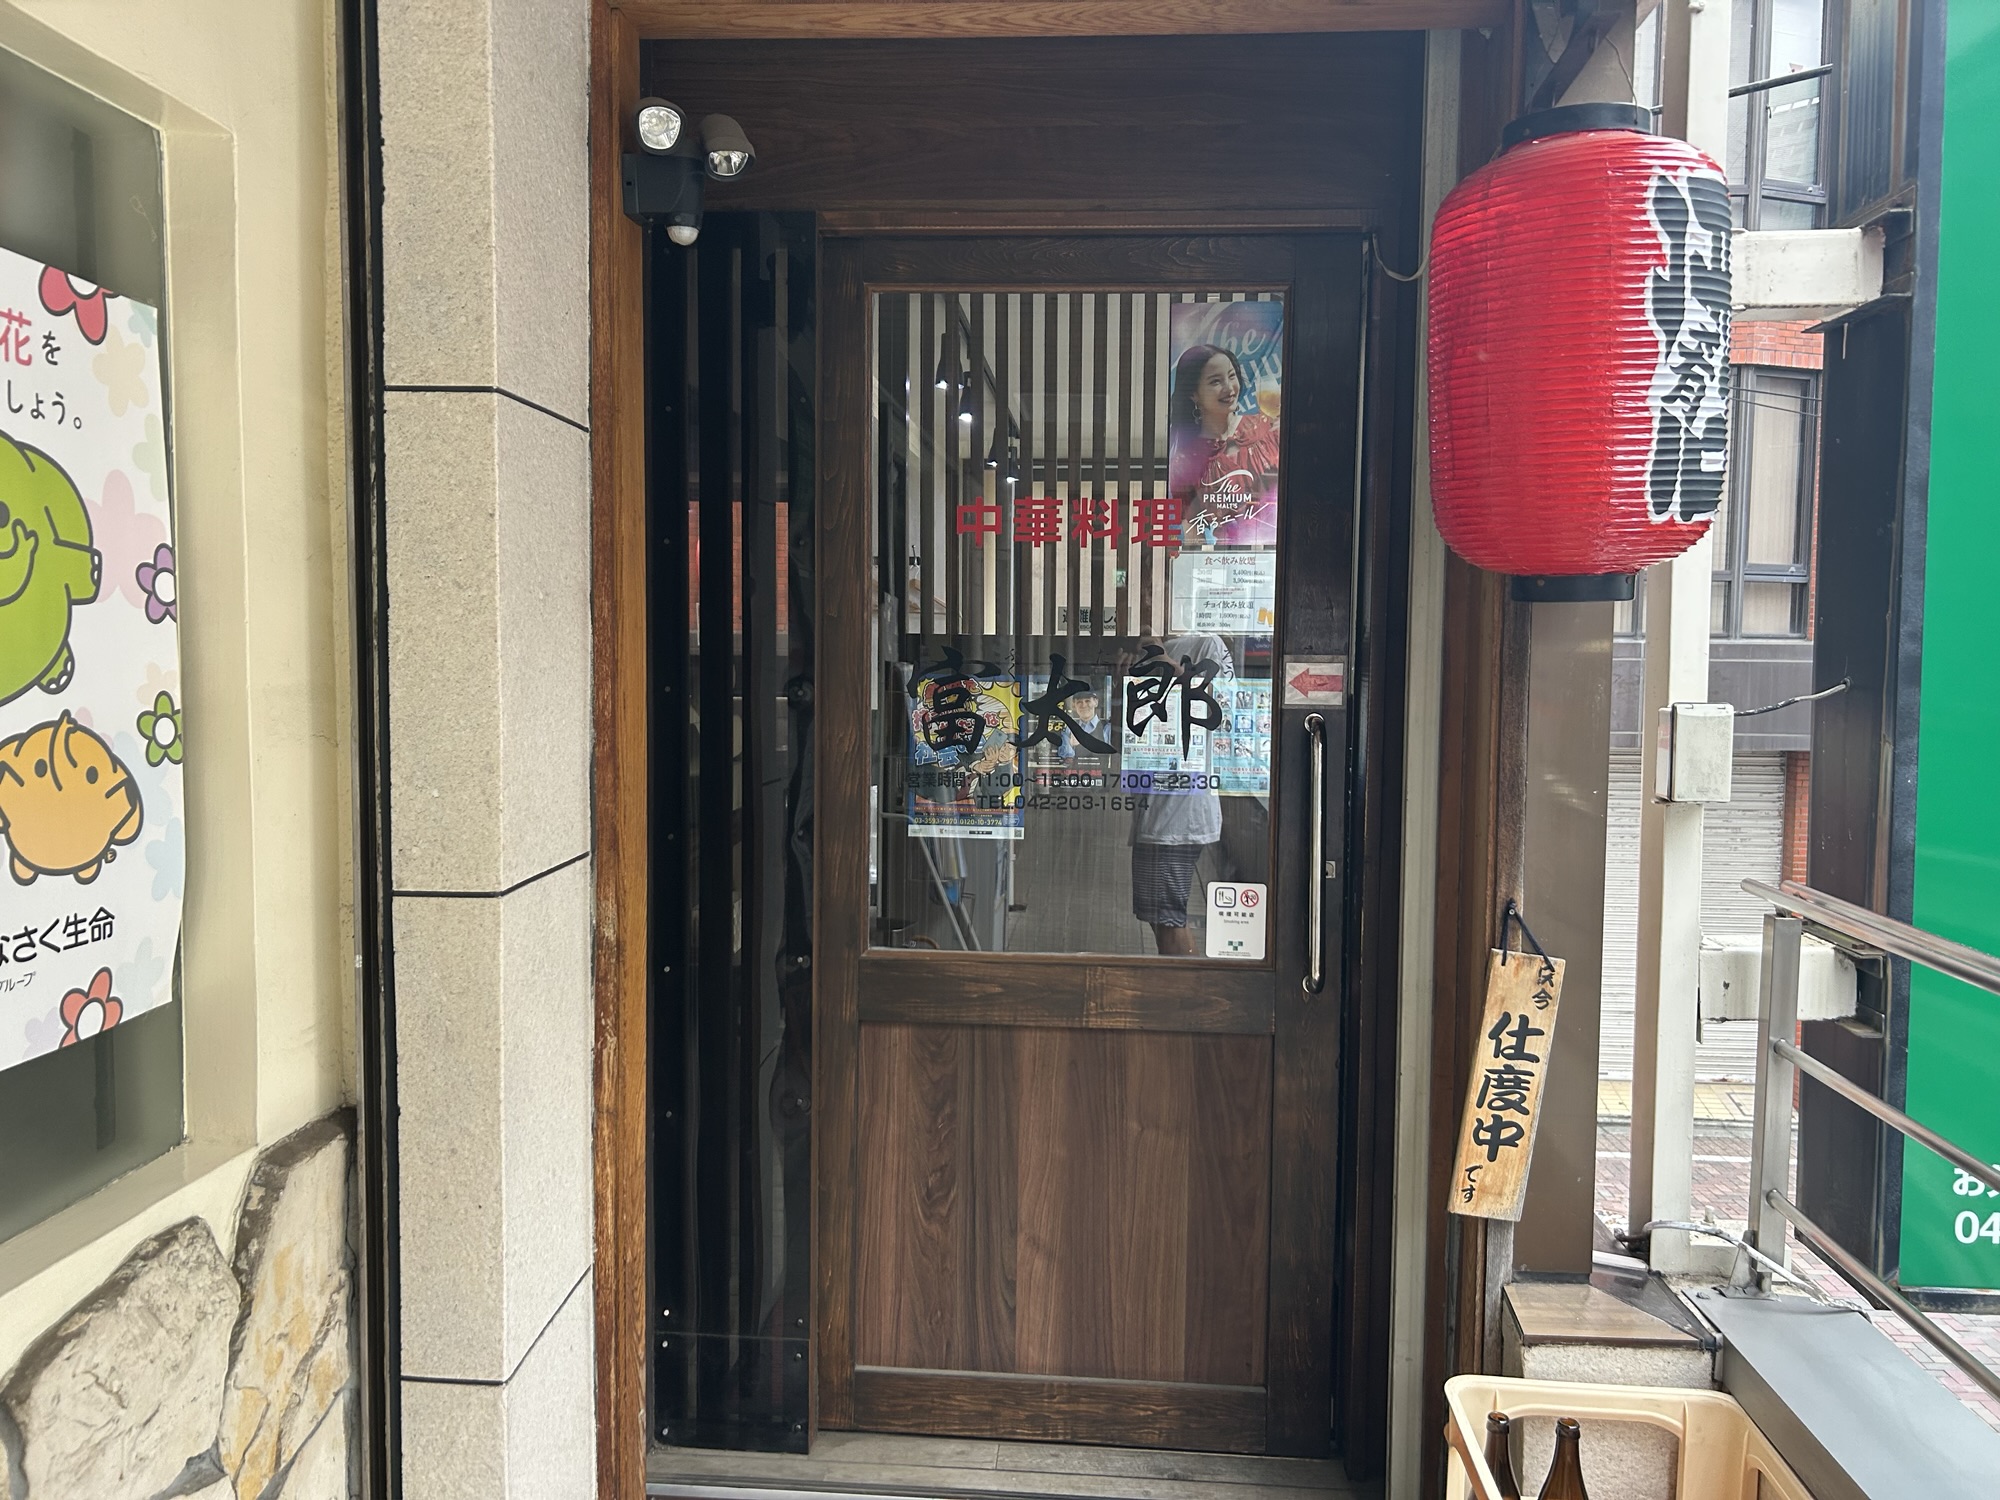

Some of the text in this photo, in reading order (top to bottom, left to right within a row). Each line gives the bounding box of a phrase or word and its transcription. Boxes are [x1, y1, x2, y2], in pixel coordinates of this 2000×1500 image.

[7, 379, 83, 430] しょう。
[1203, 493, 1252, 503] PREMIUM
[956, 496, 1183, 550] 中華料理
[1185, 503, 1271, 536] 香るエール
[1204, 556, 1256, 566] 食べ飲み放題
[1472, 1011, 1545, 1163] 仕度中
[1461, 1164, 1484, 1204] です
